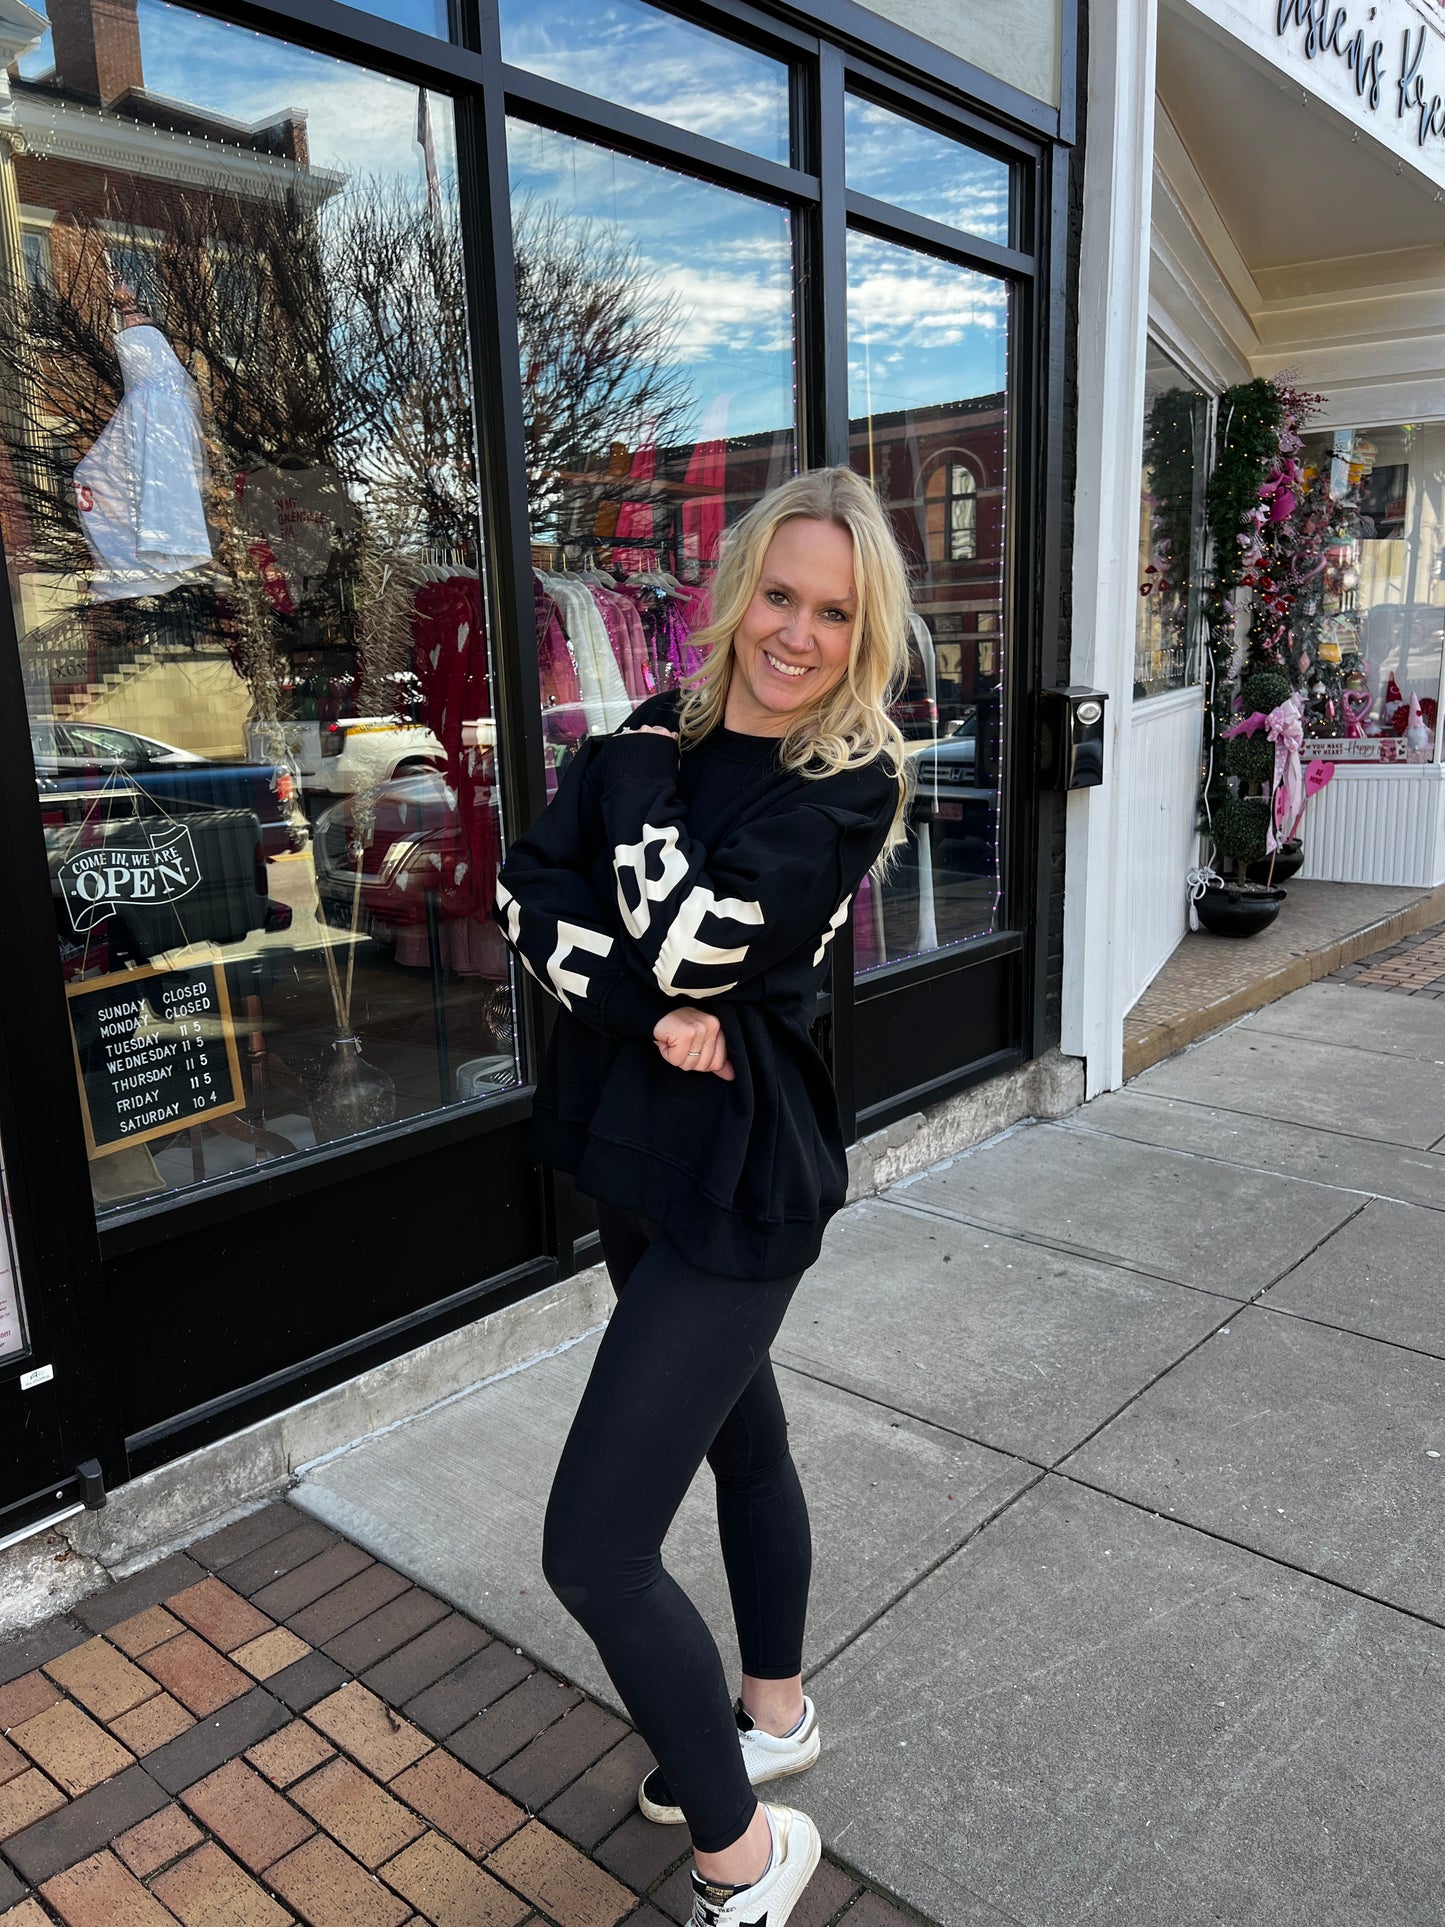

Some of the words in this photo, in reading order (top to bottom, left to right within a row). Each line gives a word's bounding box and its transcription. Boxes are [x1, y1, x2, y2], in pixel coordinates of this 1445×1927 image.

[72, 853, 107, 875] COME
[111, 852, 129, 867] IN,
[131, 853, 150, 866] WE
[154, 845, 179, 865] ARE
[76, 857, 188, 901] OPEN
[98, 998, 146, 1022] SUNDAY
[162, 981, 208, 1005] CLOSED
[100, 1014, 149, 1039] MONDAY
[165, 997, 211, 1020] CLOSED
[105, 1032, 160, 1058] TUESDAY
[179, 1024, 188, 1037] 11
[193, 1021, 201, 1032] 5
[106, 1043, 178, 1074] WEDNESDAY
[181, 1040, 191, 1053] 11
[196, 1036, 204, 1048] 5
[112, 1064, 173, 1094] THURSDAY
[185, 1058, 195, 1071] 11
[200, 1053, 208, 1066] 5
[116, 1089, 159, 1114] FRIDAY
[190, 1076, 200, 1090] 11
[203, 1072, 212, 1085] 5
[119, 1102, 180, 1133] SATURDAY
[192, 1096, 206, 1109] 10
[210, 1090, 217, 1102] 4
